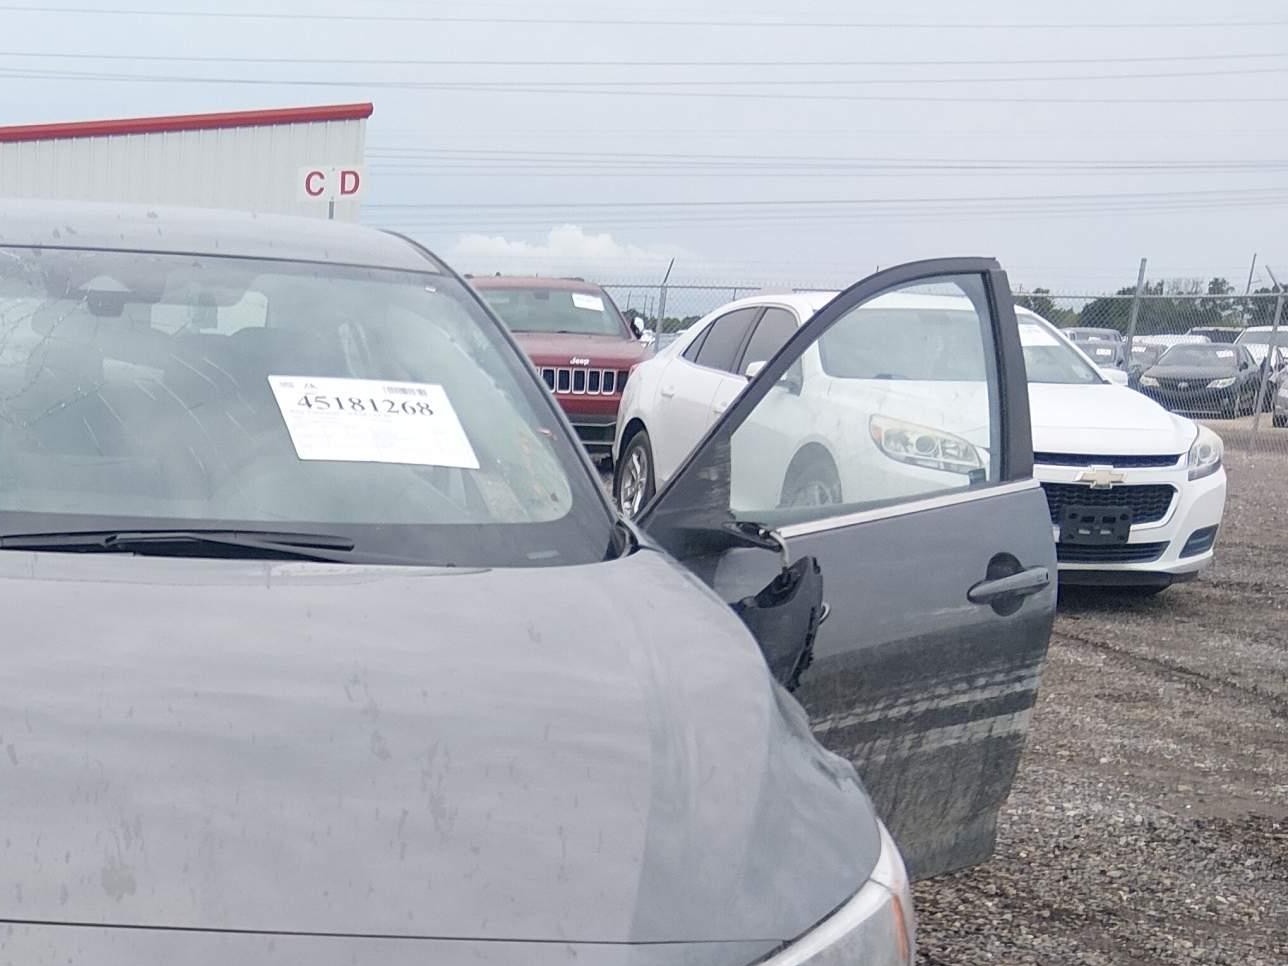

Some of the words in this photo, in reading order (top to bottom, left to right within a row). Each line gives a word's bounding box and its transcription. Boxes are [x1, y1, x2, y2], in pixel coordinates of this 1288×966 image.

[305, 171, 325, 196] C
[340, 170, 360, 195] D
[569, 356, 590, 366] Jeep
[297, 394, 435, 417] 45181268
